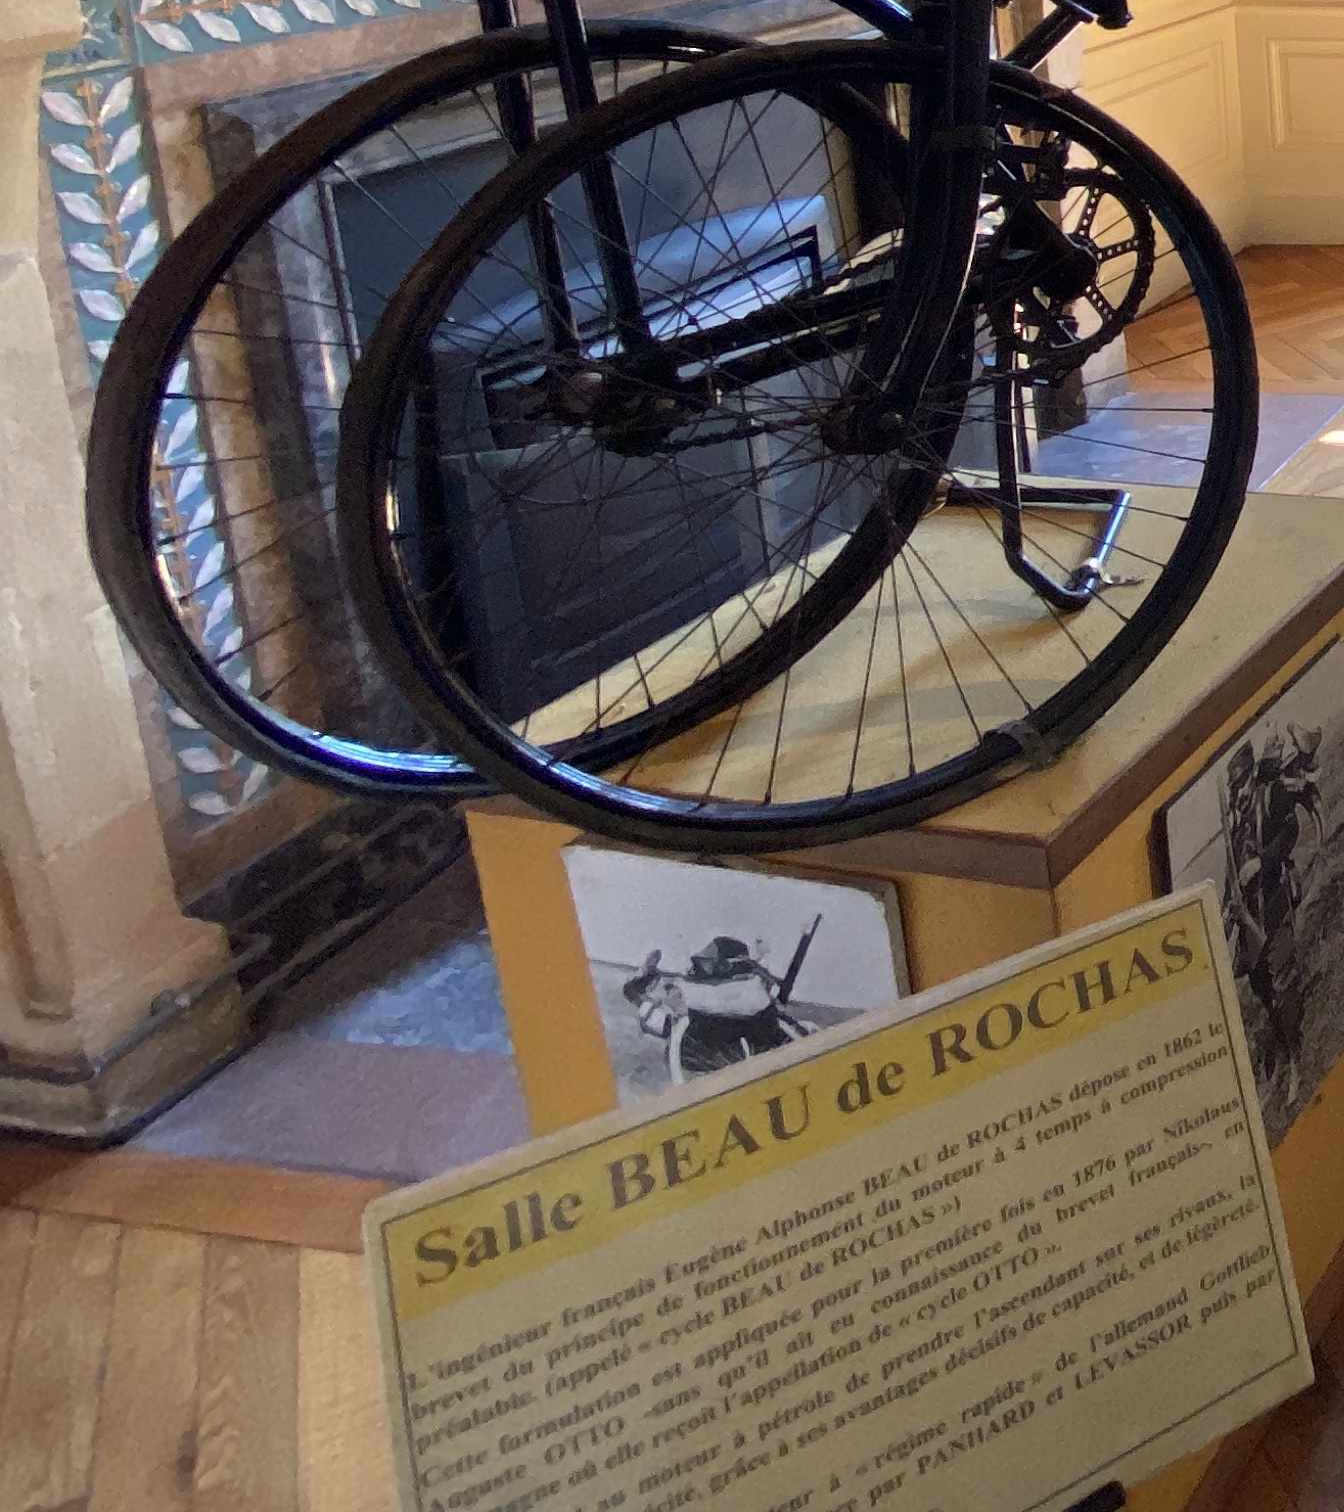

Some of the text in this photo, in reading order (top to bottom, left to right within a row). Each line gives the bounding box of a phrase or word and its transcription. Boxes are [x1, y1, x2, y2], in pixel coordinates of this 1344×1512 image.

[410, 1042, 1229, 1423] brevet du principe de fonctionnement du moteur à 4 temps à compression
[411, 929, 1197, 1289] Salle BEAU de ROCHAS
[561, 1268, 656, 1332] français
[663, 1230, 748, 1287] Eugène
[752, 1185, 856, 1249] Alphonse
[862, 1151, 929, 1197] BEAU
[935, 1138, 961, 1164] de
[965, 1091, 1064, 1151] ROCHAS
[1067, 1061, 1131, 1105] dépose
[1136, 1054, 1156, 1072] en
[1163, 1027, 1202, 1058] 1862
[1208, 1018, 1223, 1038] le
[421, 1094, 1240, 1491] Cette formulation est appliquée pour la première fois en 1876 par Nikolaus
[543, 1412, 625, 1468] OTTO
[784, 1327, 814, 1355] ait
[829, 1312, 854, 1334] eu
[868, 1239, 1004, 1315] connaissance
[1016, 1217, 1042, 1244] du
[1054, 1183, 1115, 1224] brevet
[1223, 1120, 1244, 1139] en
[603, 1435, 645, 1471] elle
[649, 1402, 717, 1452] reçoit
[867, 1319, 893, 1346] de
[914, 1281, 969, 1325] cycle
[971, 1245, 1040, 1293] OTTO
[637, 1440, 722, 1495] moteur
[731, 1427, 746, 1450] à
[756, 1384, 836, 1441] pétrole
[844, 1366, 871, 1395] de
[879, 1320, 966, 1381] prendre
[972, 1258, 1088, 1329] l'ascendant
[1094, 1240, 1126, 1266] sur
[1133, 1223, 1161, 1247] ses
[1238, 1170, 1255, 1191] la
[657, 1304, 715, 1350] cycle
[721, 1270, 791, 1317] BEAU
[798, 1255, 825, 1282] de
[830, 1204, 936, 1267] ROCHAS
[707, 1445, 771, 1495] grâce
[795, 1421, 828, 1449] ses
[832, 1364, 939, 1431] avantages
[942, 1322, 1017, 1375] décisifs
[1020, 1306, 1047, 1334] de
[1137, 1250, 1155, 1271] et
[1159, 1235, 1183, 1260] de
[867, 1471, 907, 1507] par
[916, 1397, 1037, 1475] PANHARD
[1044, 1383, 1063, 1405] et
[1072, 1311, 1193, 1391] LEVASSOR
[1198, 1287, 1238, 1327] puis
[1244, 1267, 1277, 1299] par
[873, 1417, 948, 1471] régime
[959, 1374, 1027, 1427] rapide
[1053, 1345, 1079, 1372] de
[1196, 1240, 1271, 1293] Gottlieb
